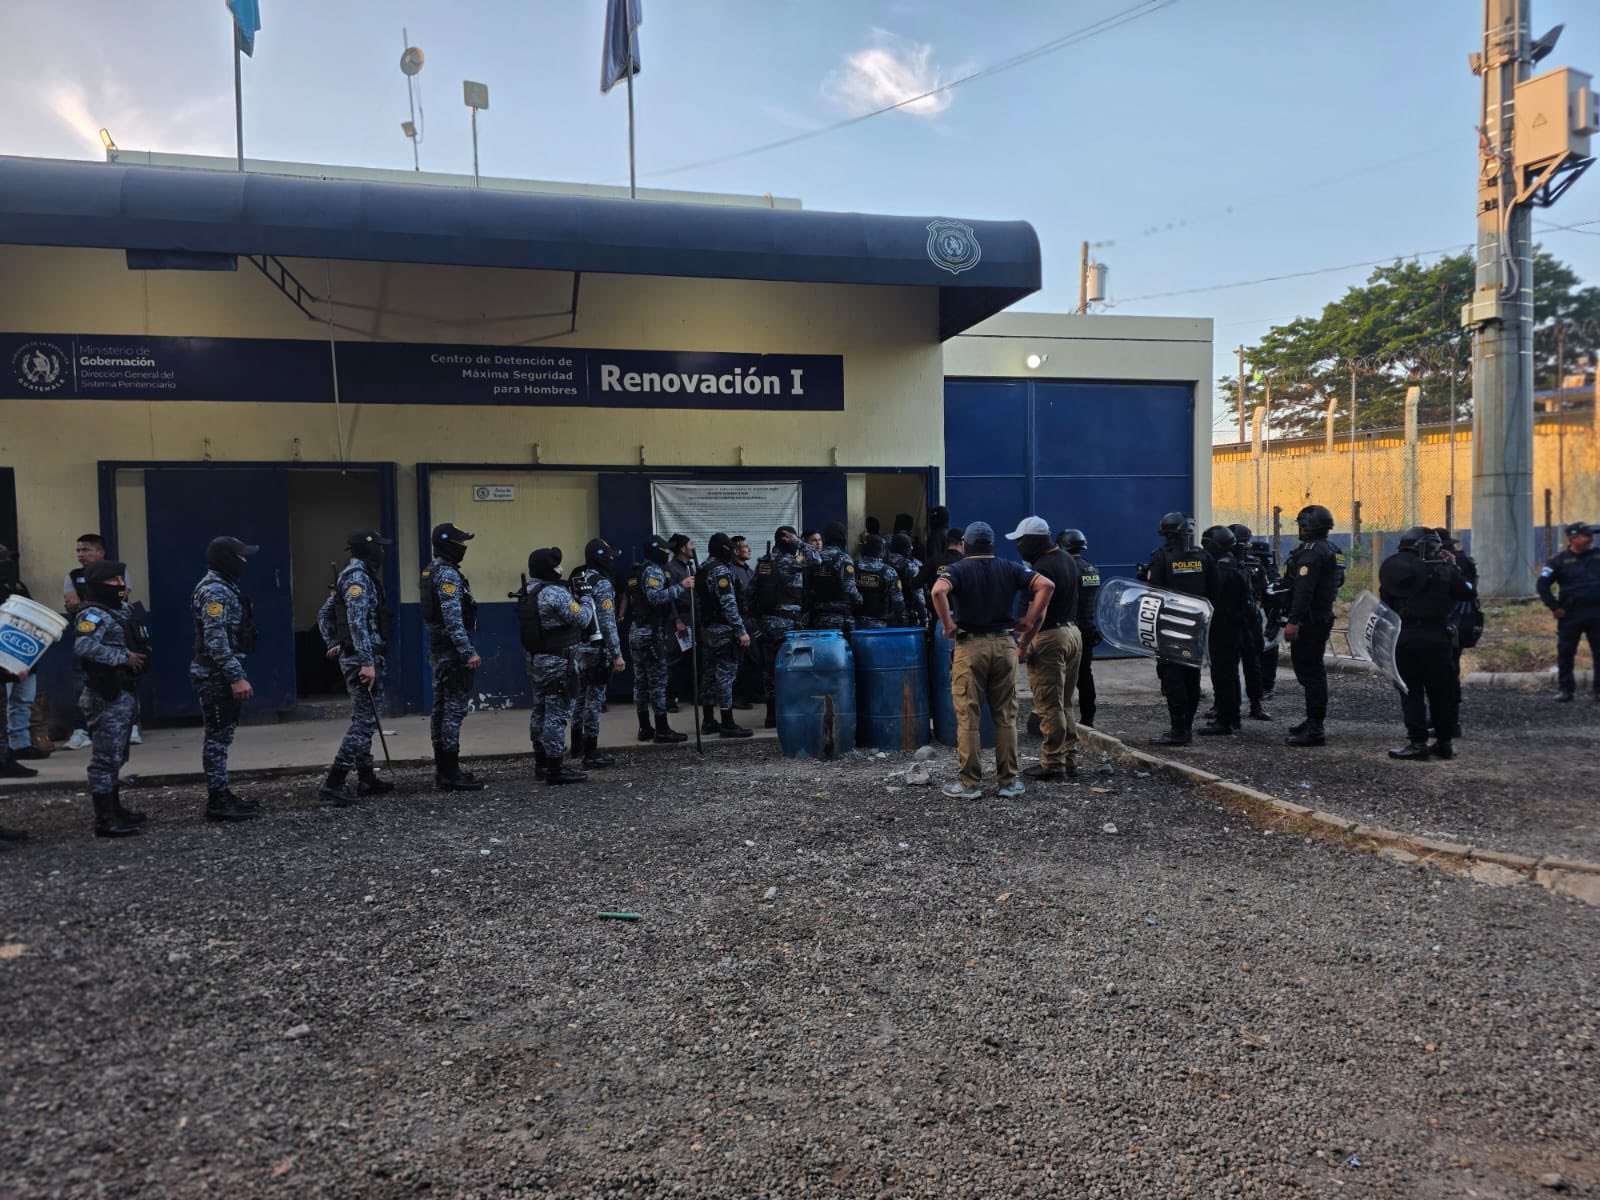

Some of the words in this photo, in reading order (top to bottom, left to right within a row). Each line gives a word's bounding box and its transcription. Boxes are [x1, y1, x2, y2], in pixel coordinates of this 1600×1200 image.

[136, 345, 151, 356] de
[79, 355, 156, 367] Gobernación
[430, 353, 473, 364] Centro
[476, 354, 491, 365] de
[495, 354, 555, 366] Detención
[558, 355, 573, 366] de
[80, 368, 123, 379] Dirección
[124, 369, 159, 380] General
[160, 369, 175, 380] del
[462, 368, 509, 379] Máxima
[513, 369, 573, 382] Seguridad
[599, 364, 782, 395] Renovación
[789, 368, 805, 395] I
[493, 384, 521, 395] para
[524, 384, 578, 395] Hombres
[2, 632, 35, 654] CELCO
